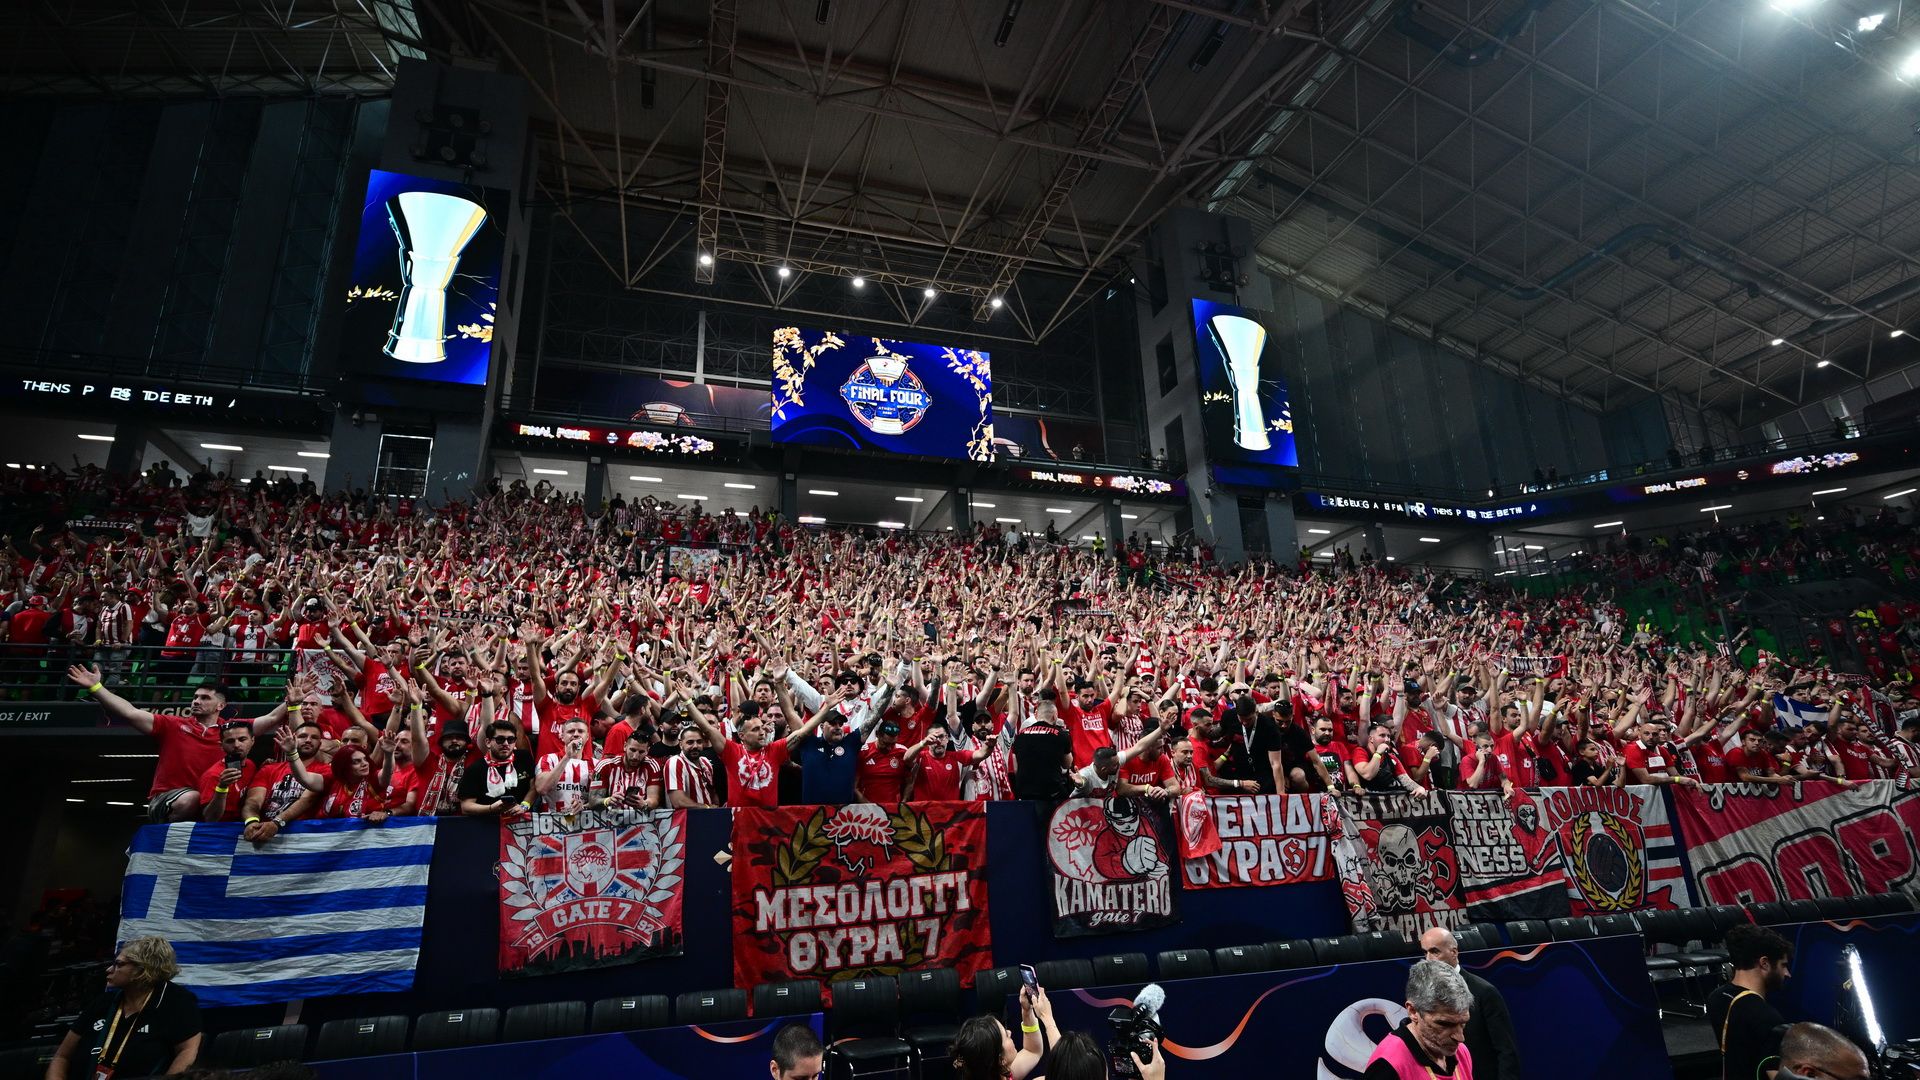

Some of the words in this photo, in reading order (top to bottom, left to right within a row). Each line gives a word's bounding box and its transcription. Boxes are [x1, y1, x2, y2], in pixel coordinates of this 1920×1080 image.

[890, 390, 923, 406] FOUR
[24, 712, 51, 721] EXIT
[1205, 793, 1325, 838] ΕΝΙΔΙ
[1450, 793, 1510, 821] RED
[1453, 819, 1517, 846] SICK
[1307, 836, 1327, 877] 7
[1458, 845, 1527, 873] NESS
[754, 871, 970, 932] ΜΕΣΟΛΟΓΓΙ
[1054, 873, 1171, 918] KAMATERO
[551, 901, 615, 928] GATE
[618, 901, 632, 921] 7
[637, 919, 653, 936] 92
[1088, 910, 1131, 927] gate
[1132, 910, 1143, 923] 7
[526, 933, 545, 948] 19
[788, 923, 903, 972] ΘΥΡΑ
[916, 917, 941, 957] 7
